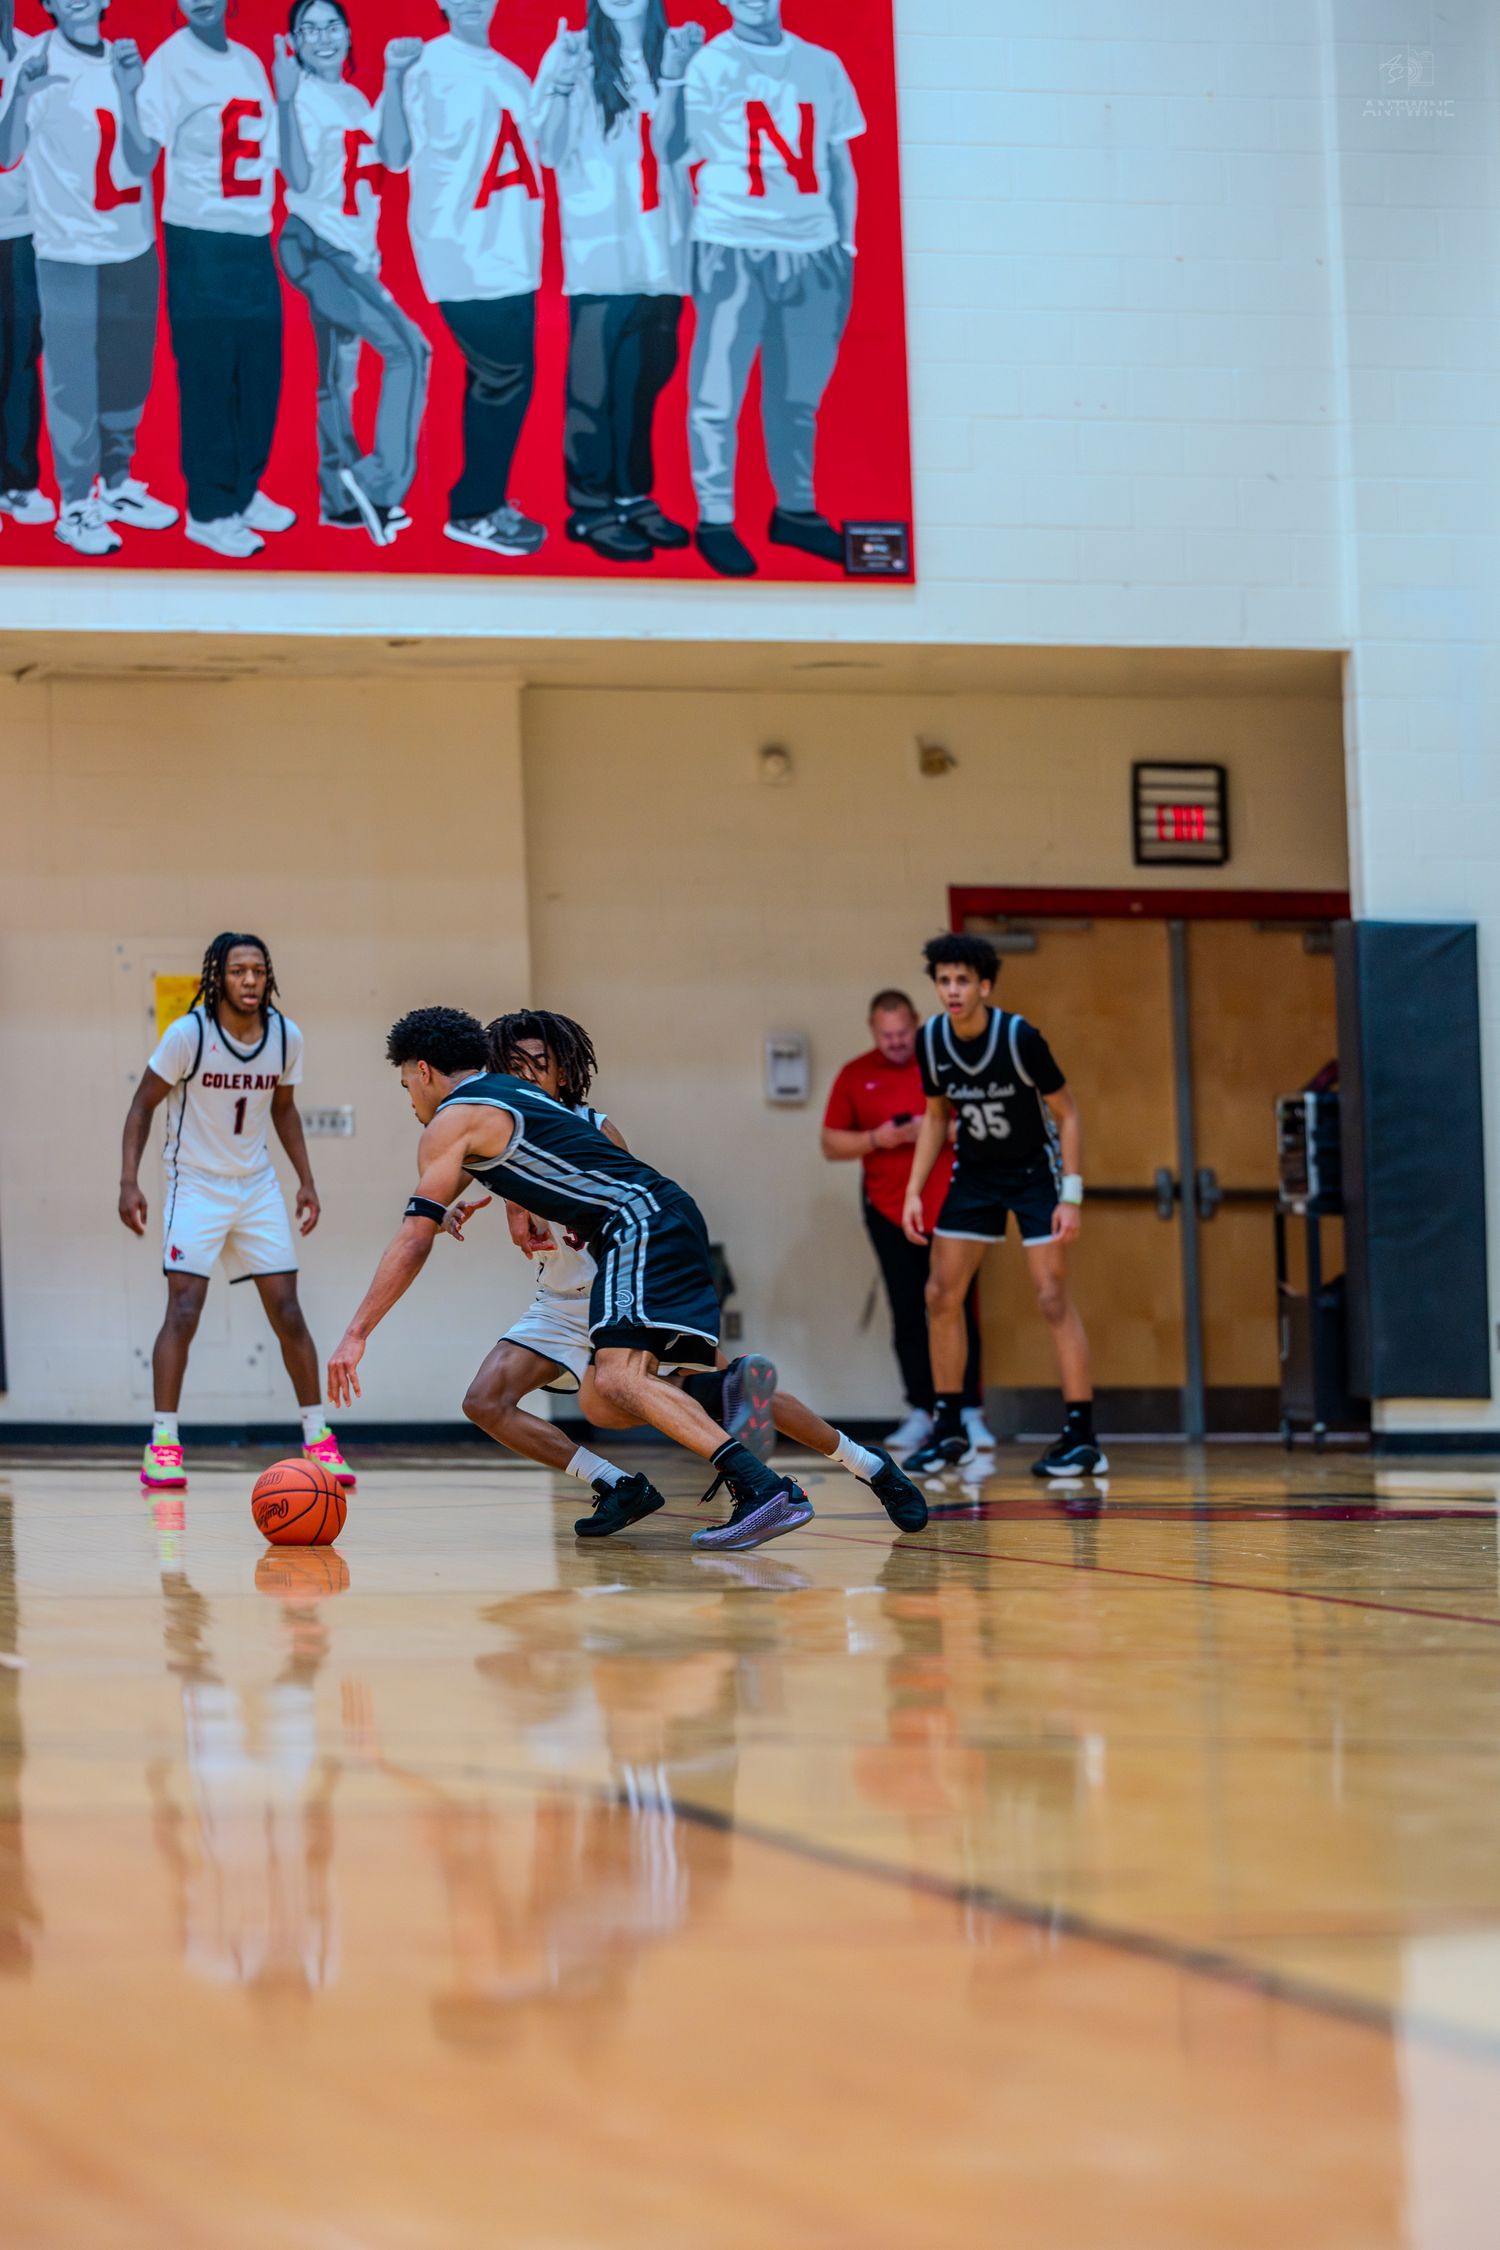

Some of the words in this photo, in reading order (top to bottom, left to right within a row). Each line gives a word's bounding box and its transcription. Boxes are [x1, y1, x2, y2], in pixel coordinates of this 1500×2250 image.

[474, 109, 541, 210] A
[746, 101, 819, 196] N
[202, 1072, 280, 1091] COLERAIN
[234, 1097, 247, 1135] 1
[961, 1102, 1011, 1141] 35
